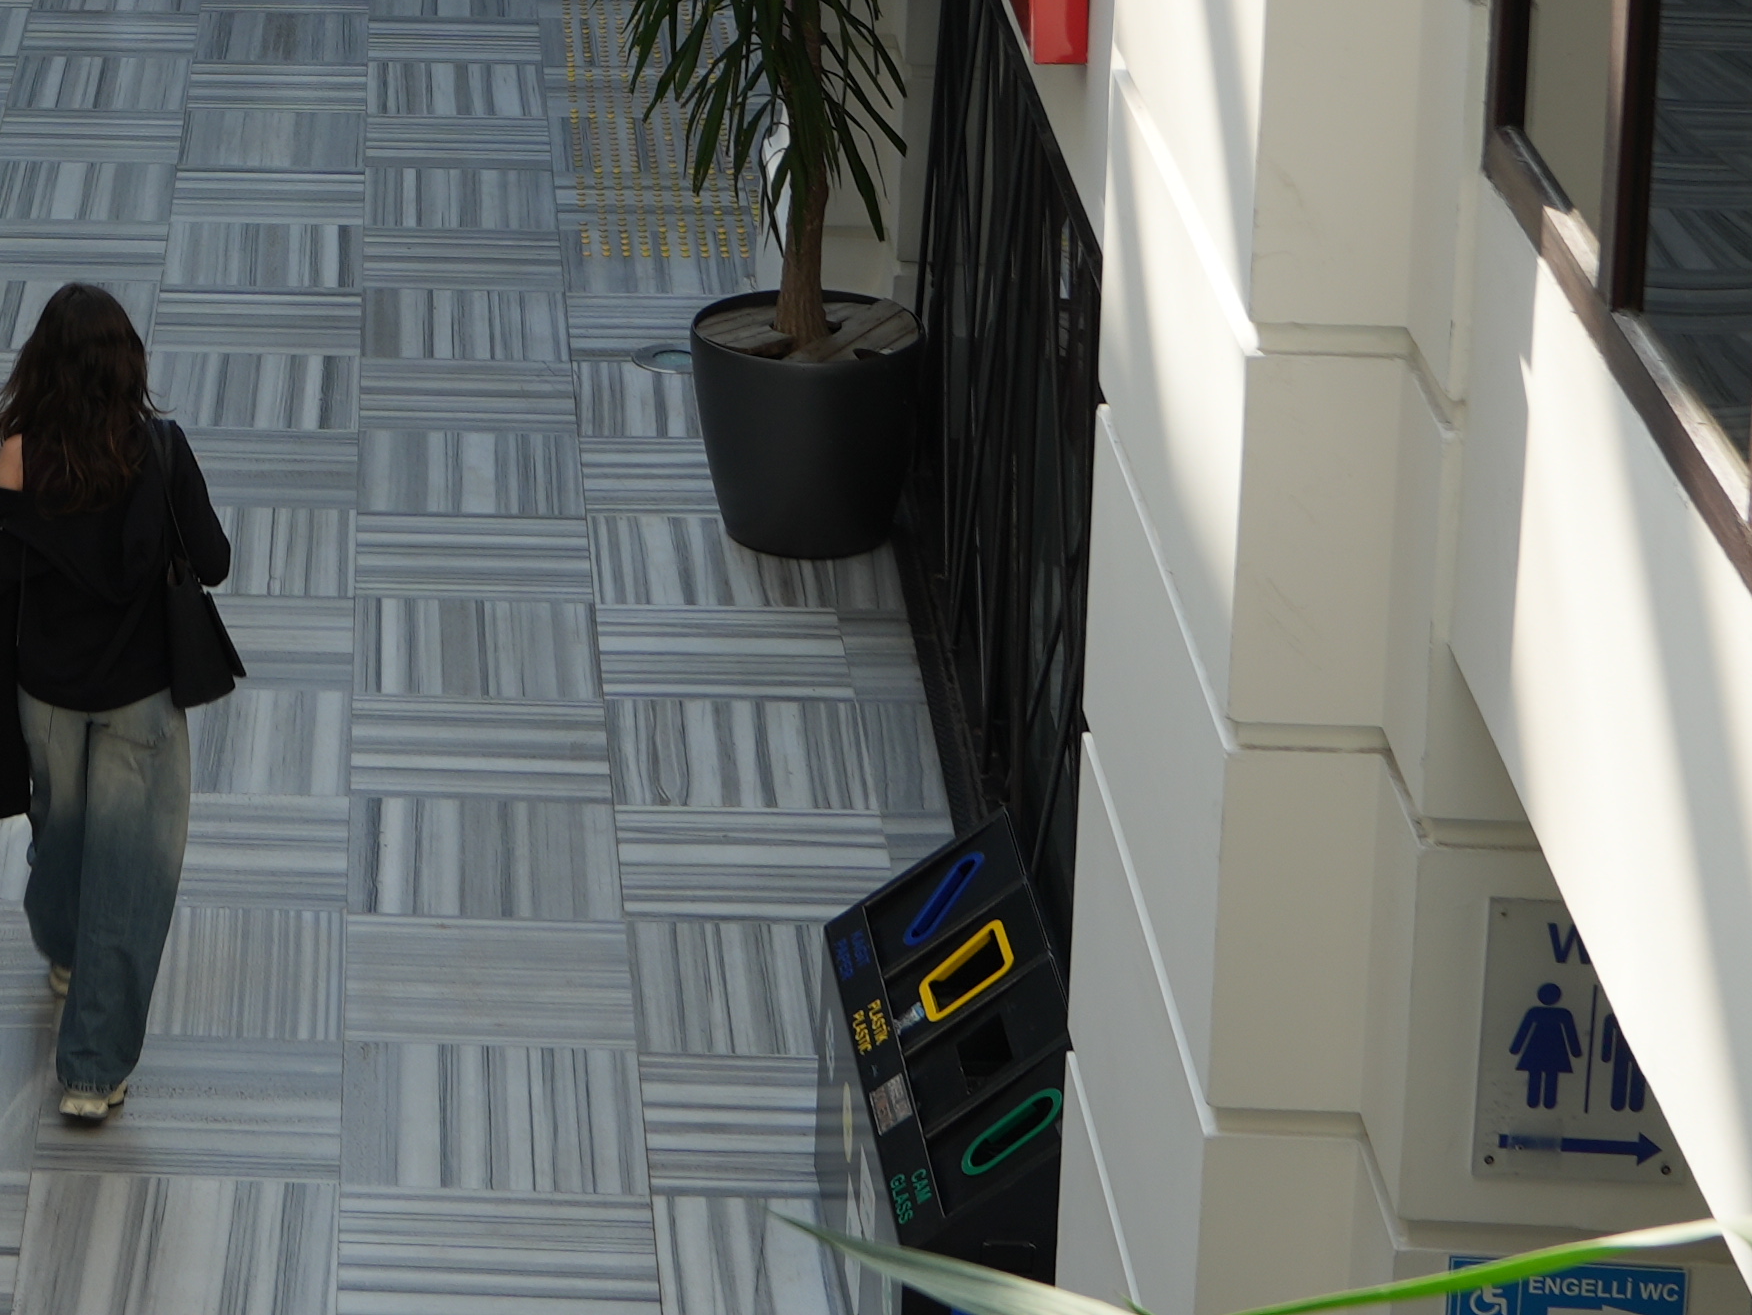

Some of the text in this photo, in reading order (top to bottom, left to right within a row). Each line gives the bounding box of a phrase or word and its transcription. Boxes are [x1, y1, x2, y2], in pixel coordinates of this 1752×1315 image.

[889, 1172, 915, 1225] GLASS
[909, 1167, 933, 1206] CAM
[1527, 1274, 1681, 1303] ENGELLİ WC
